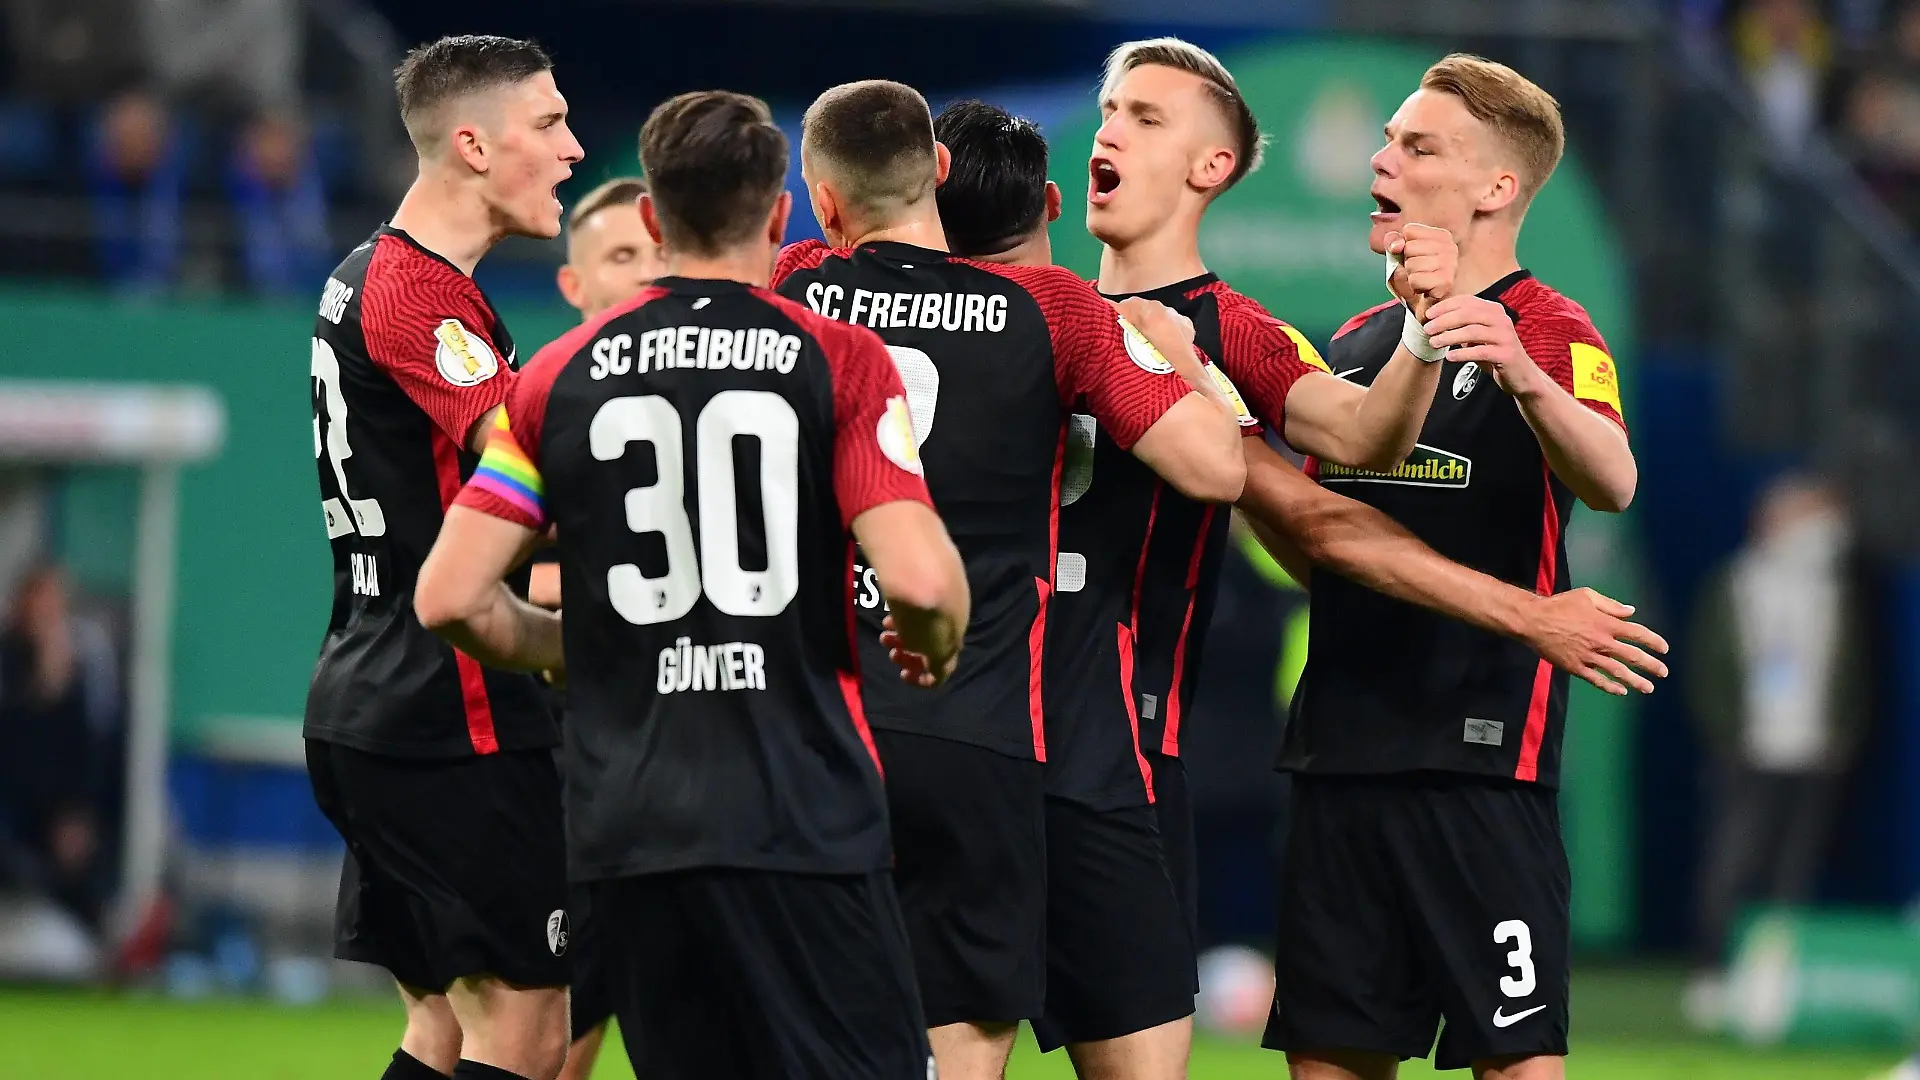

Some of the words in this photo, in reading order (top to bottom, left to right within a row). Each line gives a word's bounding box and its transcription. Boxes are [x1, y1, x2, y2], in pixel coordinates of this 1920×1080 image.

[803, 282, 845, 321] SC
[848, 288, 1008, 333] FREIBURG
[589, 333, 633, 381] SC
[637, 325, 802, 375] FREIBURG
[589, 389, 800, 626] 30
[656, 635, 767, 695] GÜNTER
[1493, 919, 1537, 998] 3
